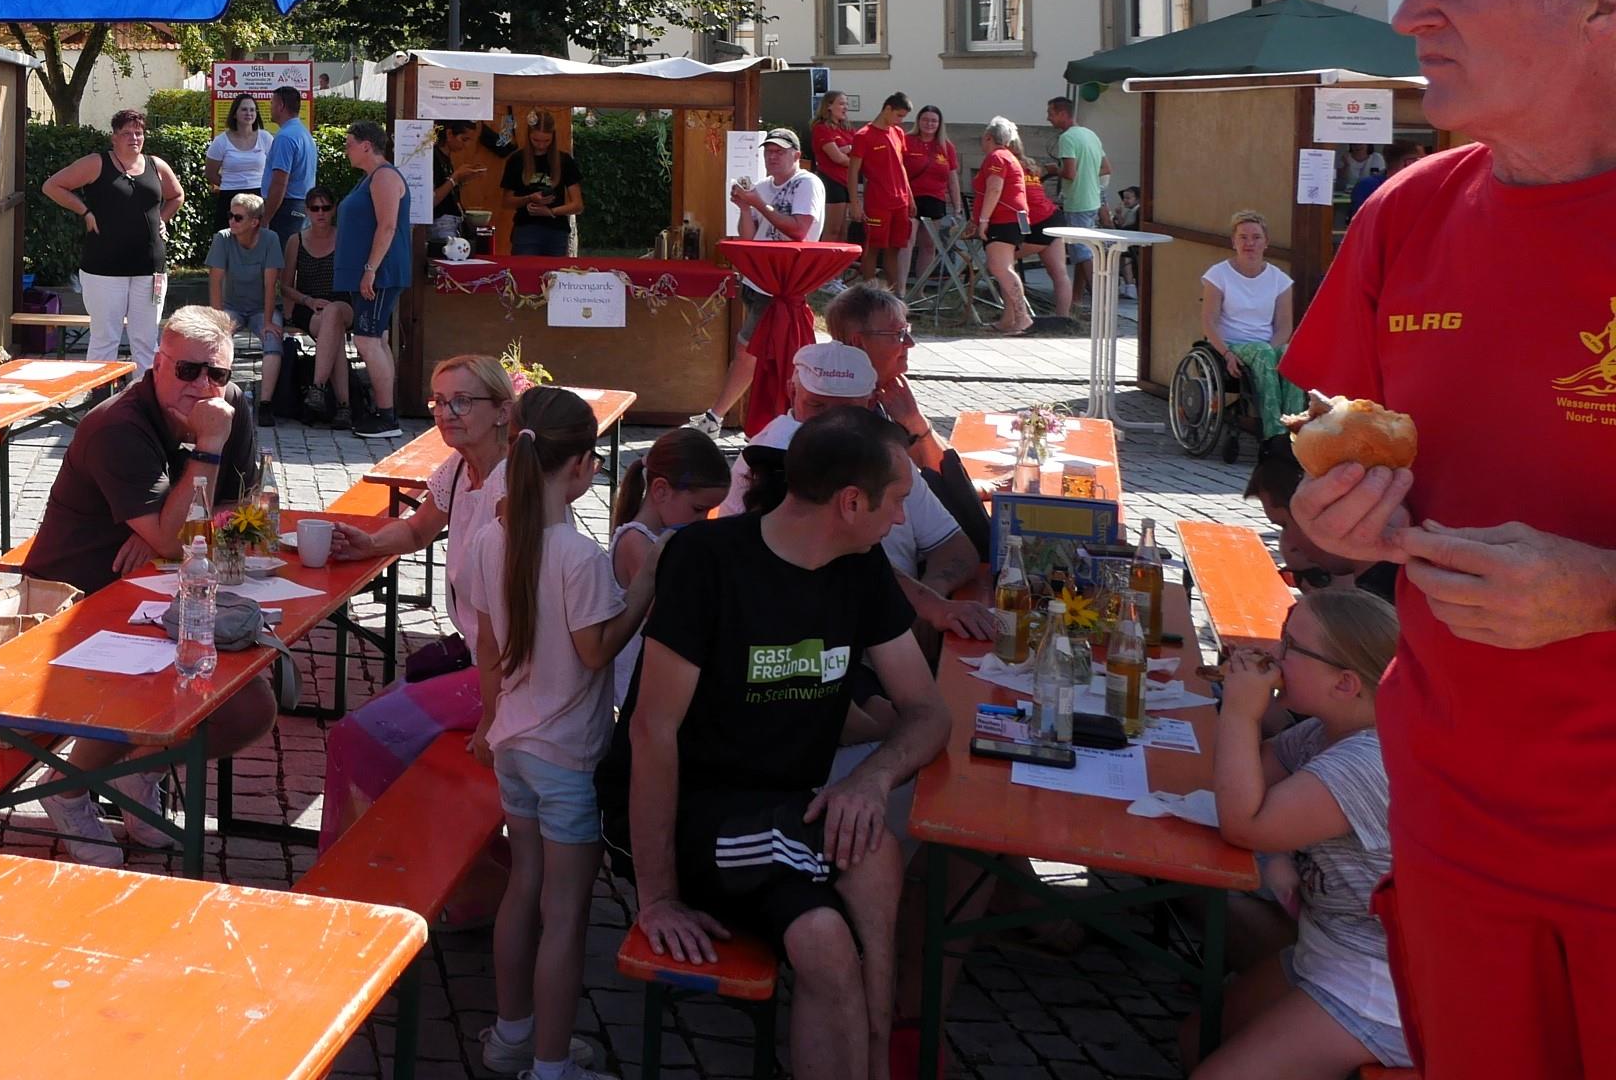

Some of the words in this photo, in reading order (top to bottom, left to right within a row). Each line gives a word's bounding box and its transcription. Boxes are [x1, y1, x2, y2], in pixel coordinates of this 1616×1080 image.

[1389, 312, 1463, 333] DLRG
[1566, 411, 1597, 423] Nord-
[753, 648, 792, 665] Gast
[745, 688, 761, 703] in
